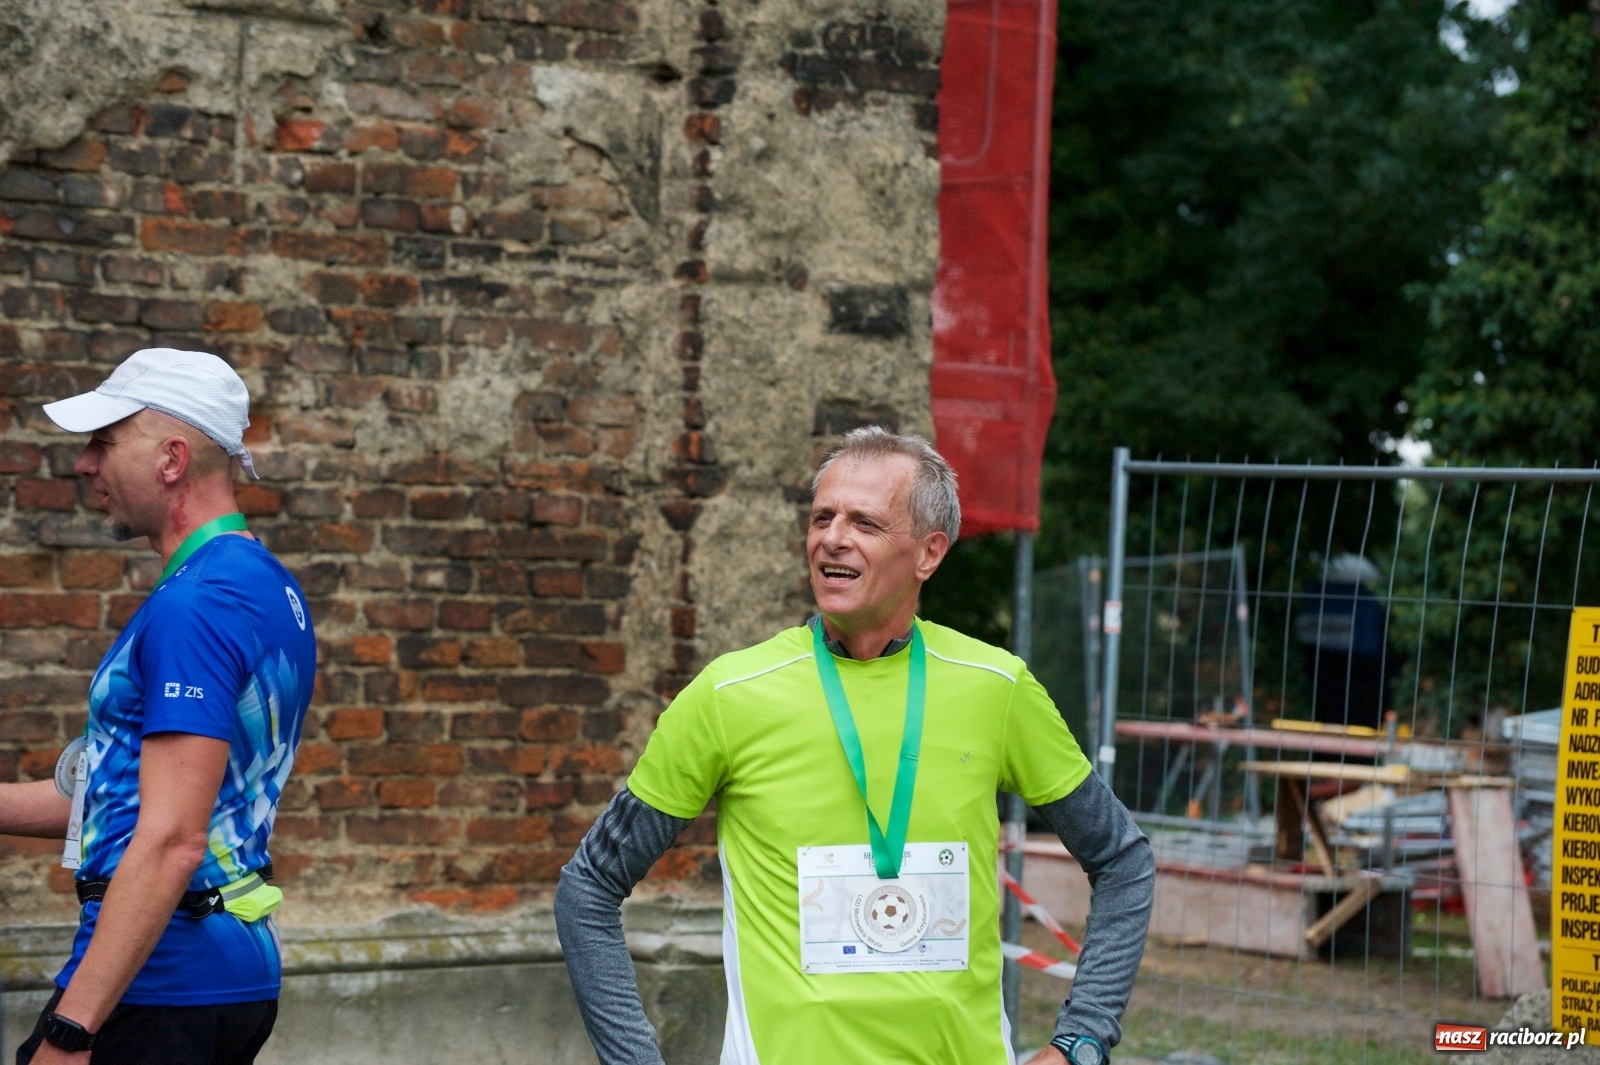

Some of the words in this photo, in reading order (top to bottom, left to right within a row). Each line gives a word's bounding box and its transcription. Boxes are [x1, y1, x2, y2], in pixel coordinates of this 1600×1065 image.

[185, 686, 203, 698] ZIS
[1571, 708, 1588, 727] NR
[1567, 760, 1600, 780] INWE
[1561, 892, 1600, 914] PROJE
[1561, 918, 1600, 941] INSPE
[1561, 996, 1593, 1013] STRAŻ
